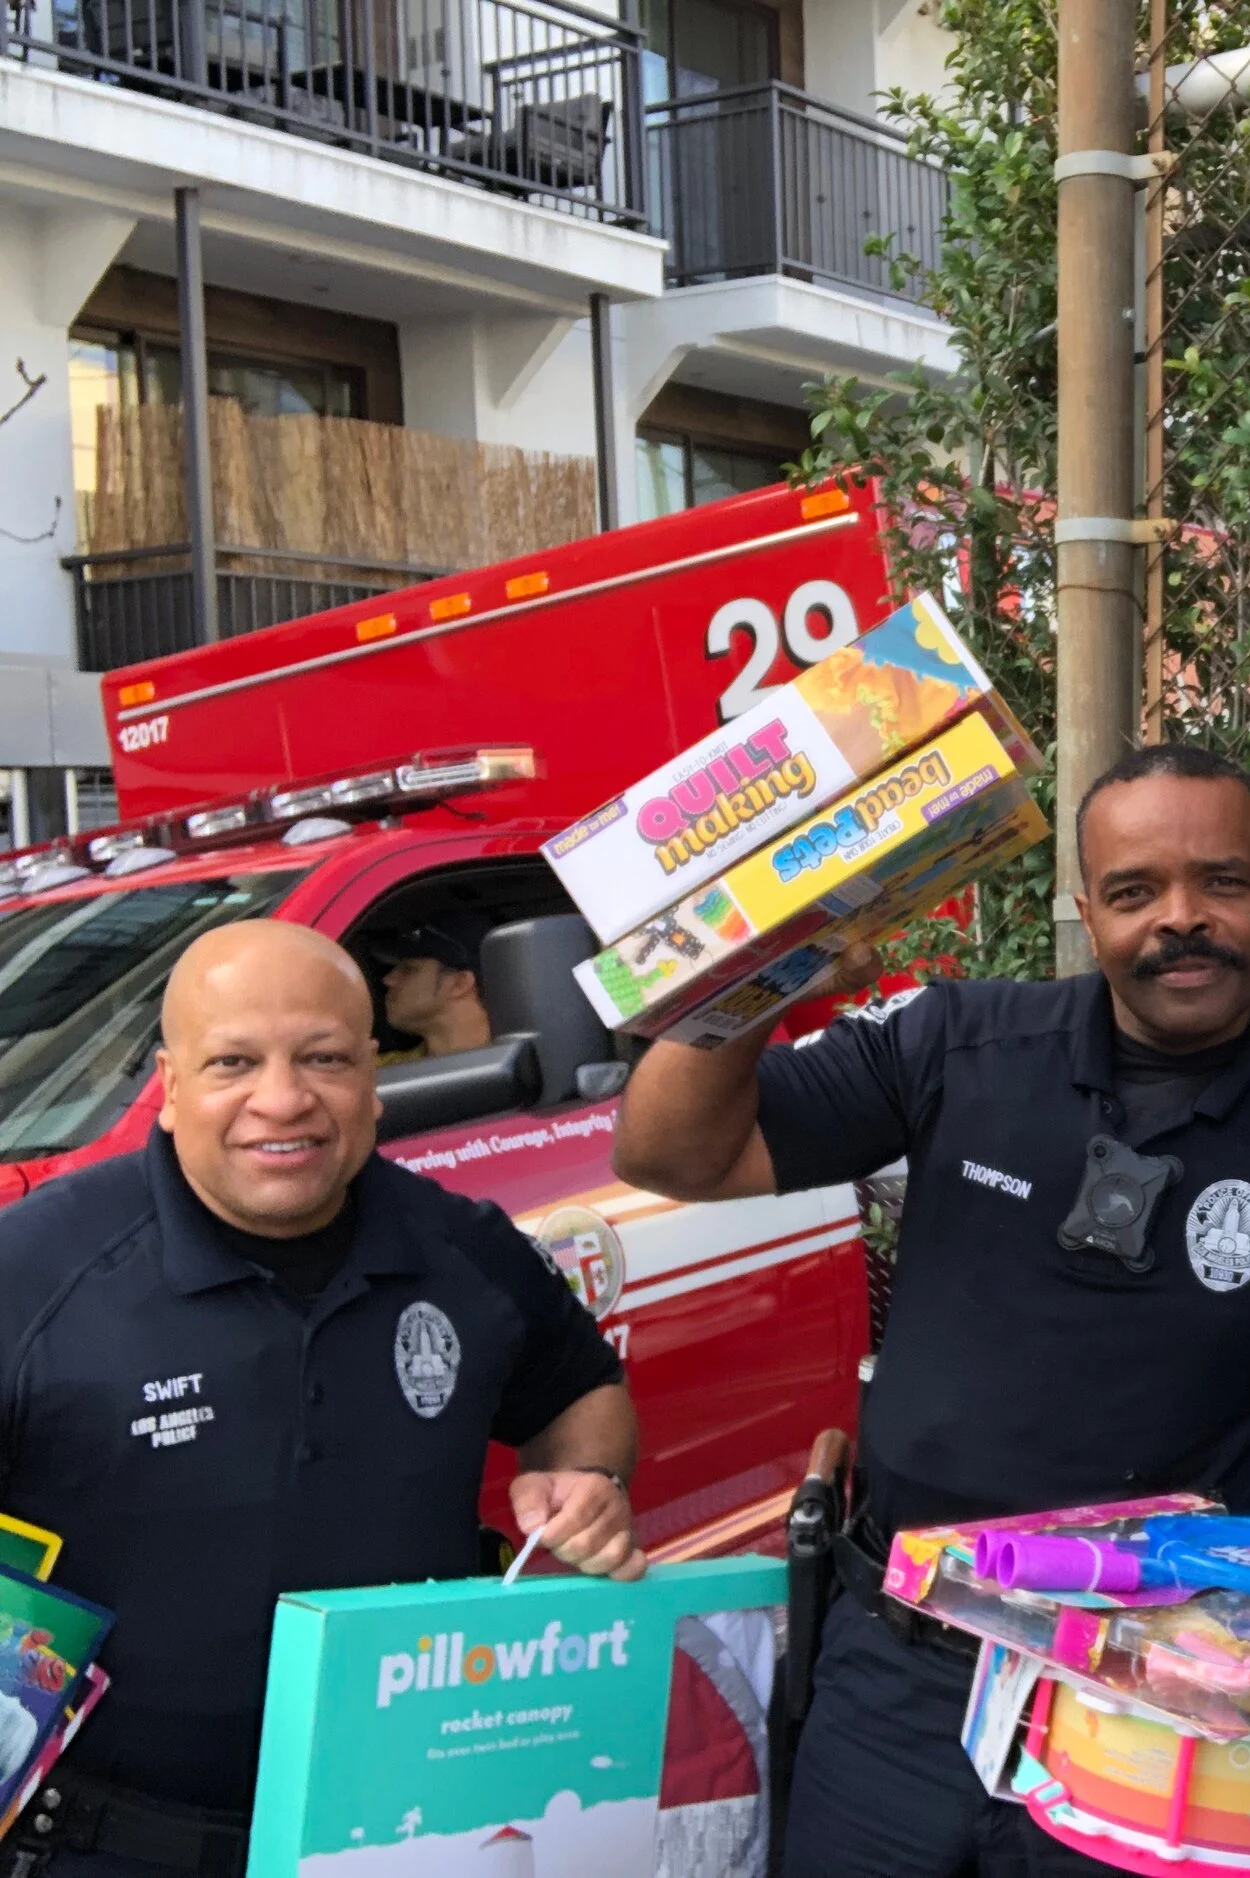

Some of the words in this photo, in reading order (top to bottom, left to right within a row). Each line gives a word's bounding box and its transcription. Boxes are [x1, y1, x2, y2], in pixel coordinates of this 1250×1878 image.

[118, 715, 169, 753] 12017
[636, 718, 792, 844] QUILT
[853, 749, 952, 832] bead
[958, 767, 995, 797] made
[654, 750, 817, 876] making
[552, 1112, 614, 1140] Integrity
[961, 1159, 1032, 1199] THOMPSON
[143, 1373, 203, 1402] SWIFT
[376, 1620, 629, 1709] pillowfort
[441, 1709, 503, 1735] rocket
[506, 1704, 573, 1725] canopy
